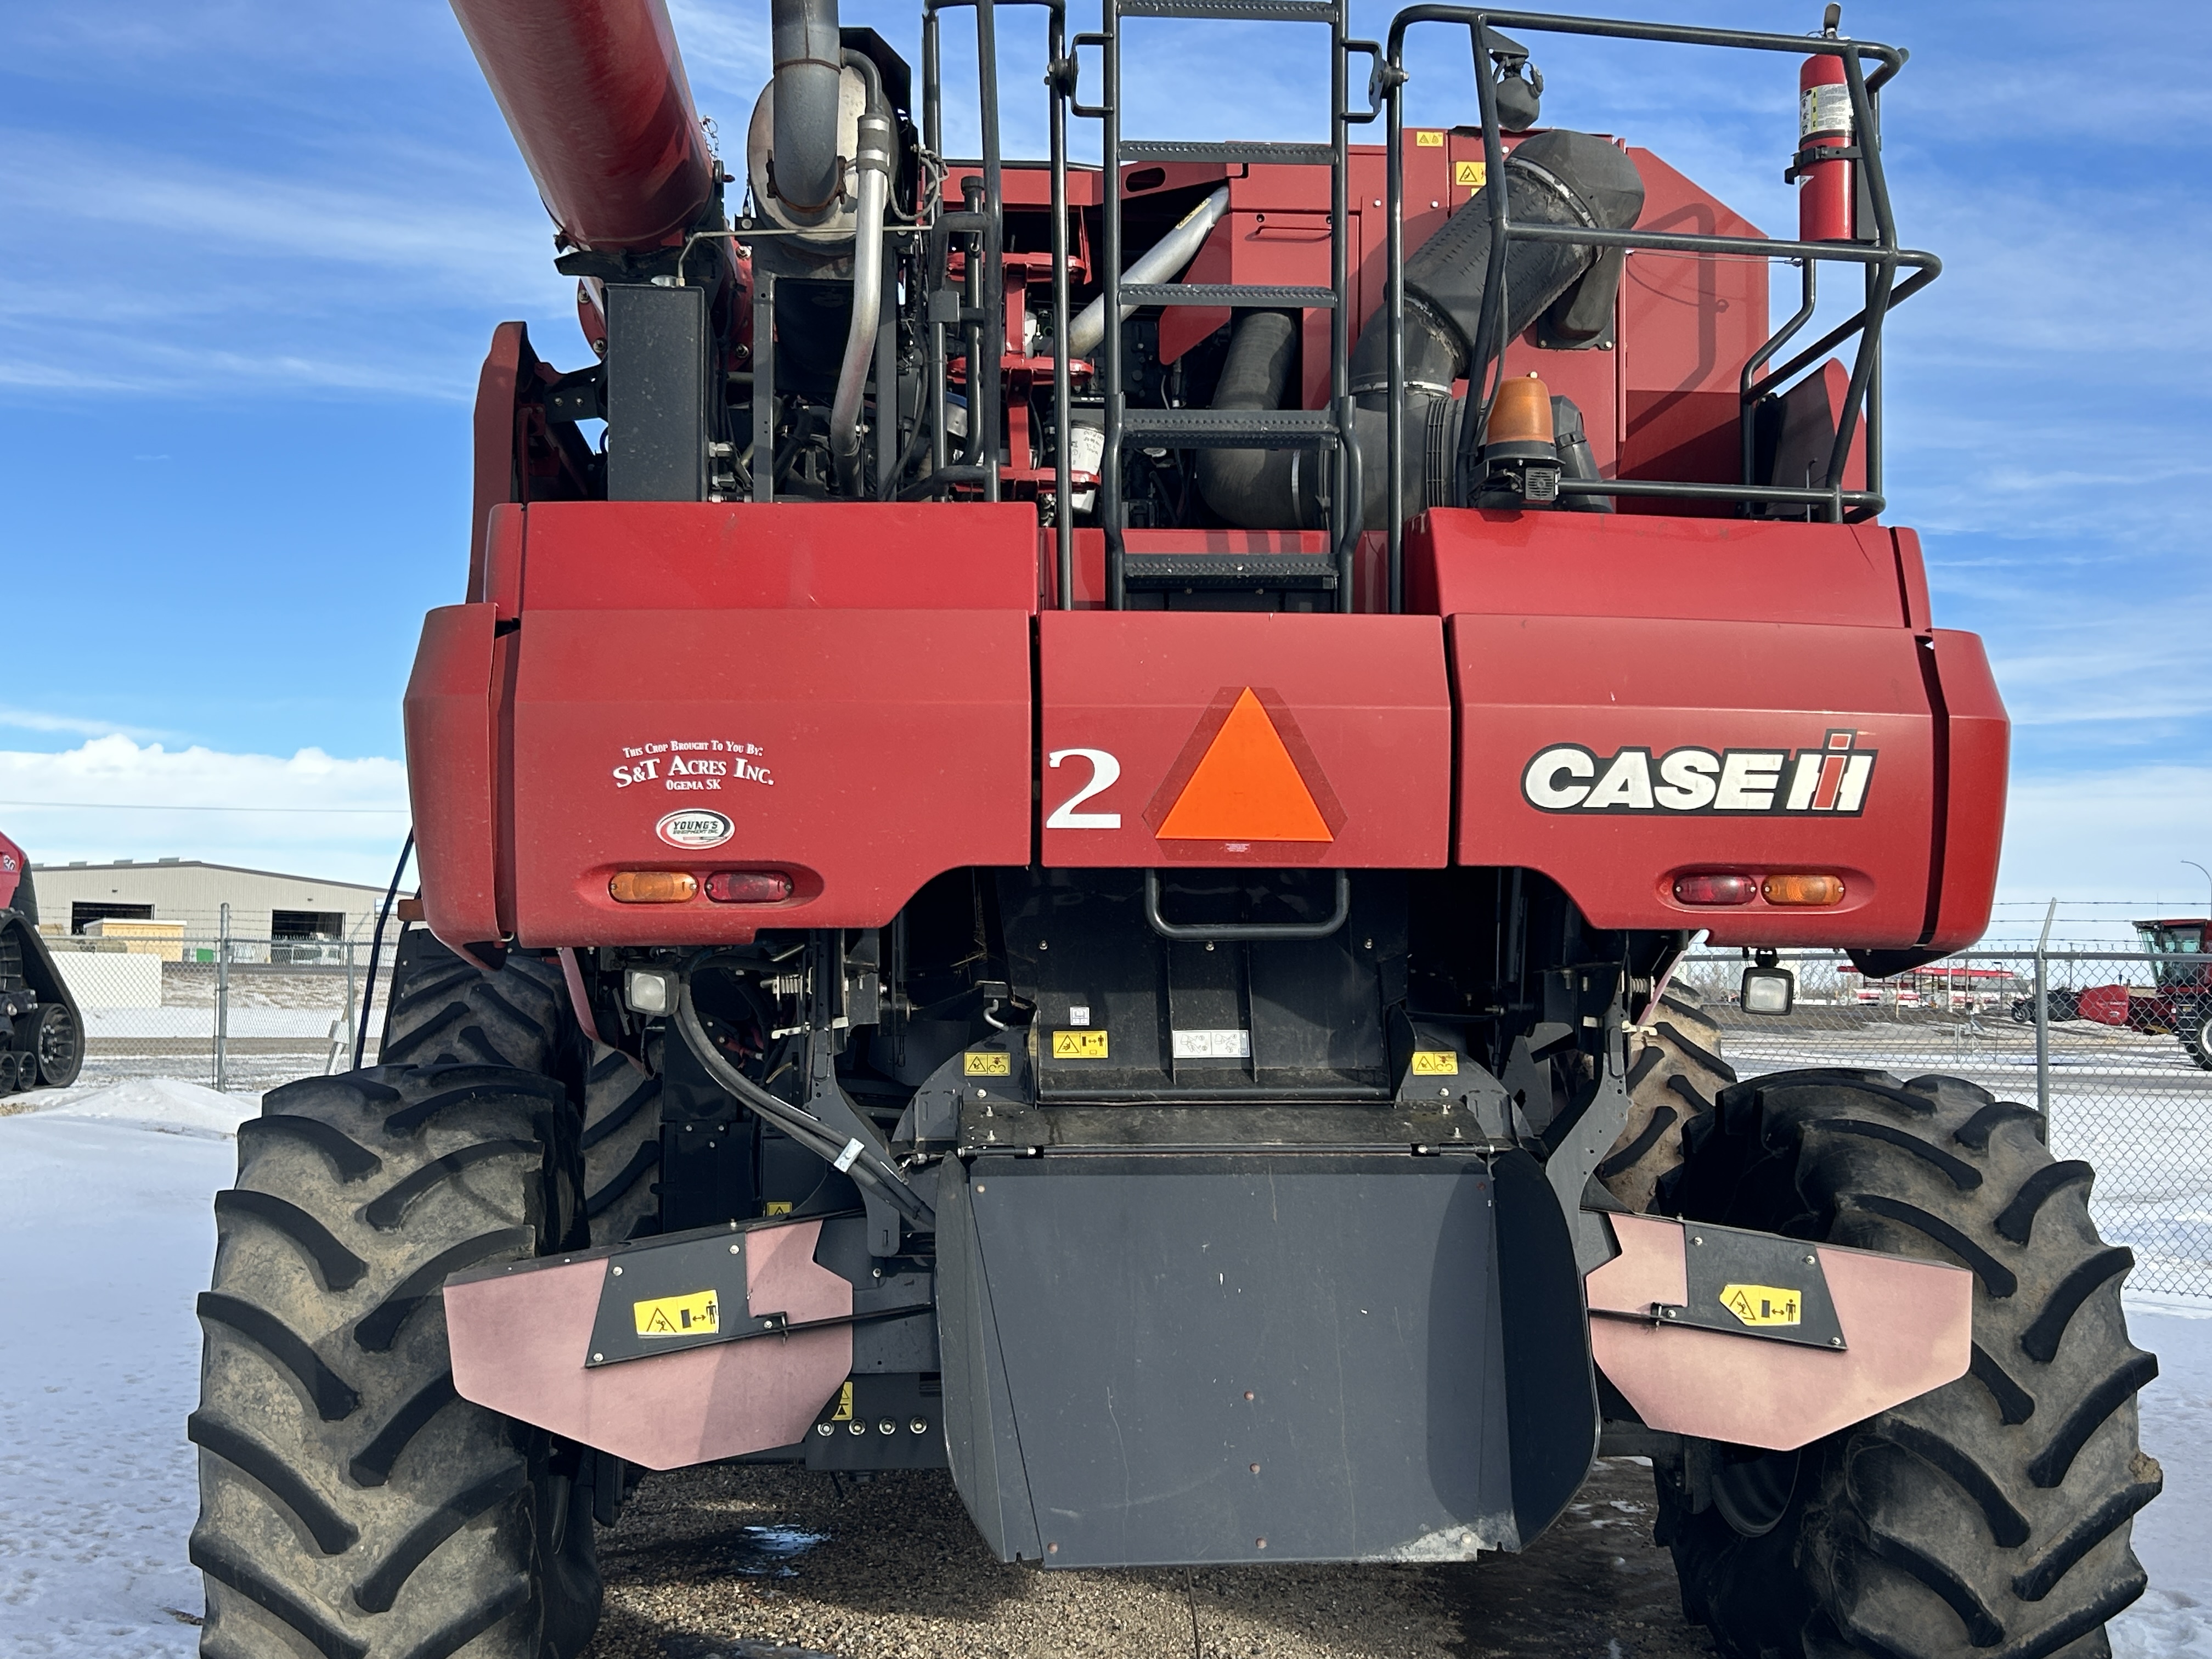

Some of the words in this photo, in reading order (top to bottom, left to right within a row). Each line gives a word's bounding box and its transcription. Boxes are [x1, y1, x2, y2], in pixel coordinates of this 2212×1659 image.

[613, 758, 661, 788] S&T
[668, 755, 727, 776] ACRES
[706, 779, 721, 790] SK
[1526, 748, 1784, 810] CASE
[1046, 748, 1121, 829] 2
[674, 821, 719, 830] YOUNG'S
